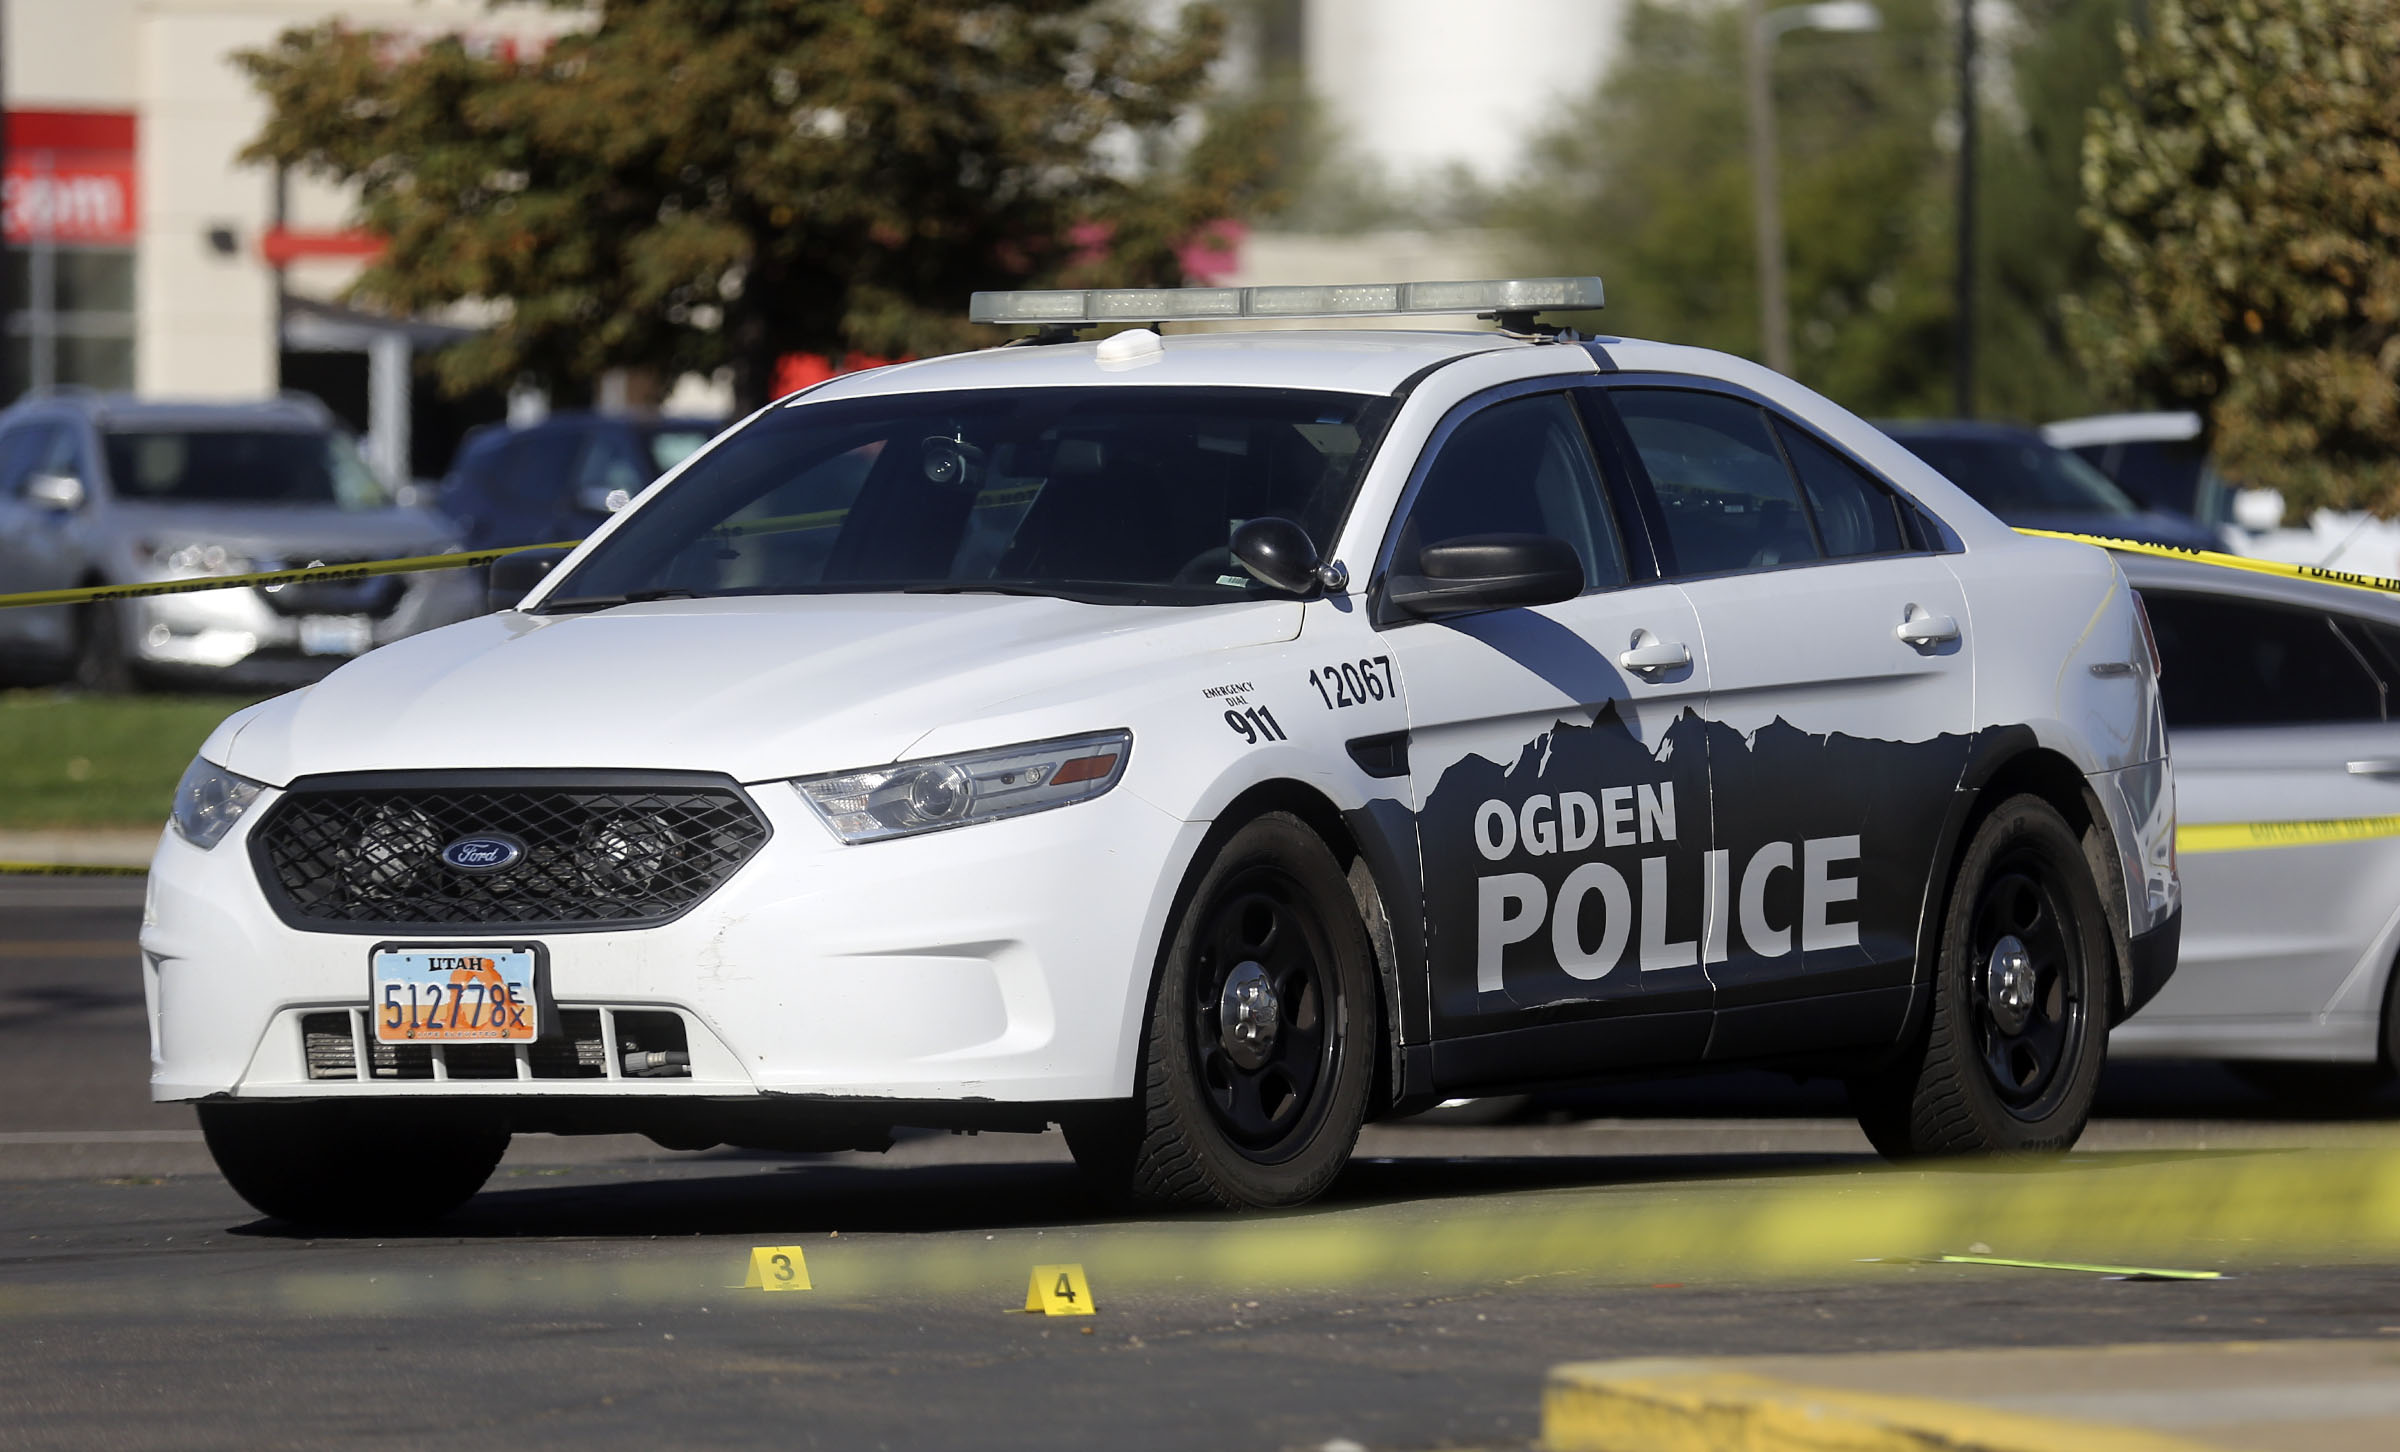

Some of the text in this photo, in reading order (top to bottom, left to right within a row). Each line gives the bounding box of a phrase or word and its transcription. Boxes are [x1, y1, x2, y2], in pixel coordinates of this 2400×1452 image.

[1202, 681, 1255, 699] EMERGENCY
[1309, 655, 1396, 710] 12067
[1225, 695, 1248, 707] DIAL
[1224, 705, 1288, 744] 911
[1473, 781, 1677, 861] OGDEN
[457, 843, 500, 862] Ford
[1477, 834, 1861, 993] POLICE
[428, 957, 484, 971] UTAH
[385, 983, 506, 1029] 512778
[771, 1254, 795, 1281] 3
[1054, 1272, 1076, 1303] 4
